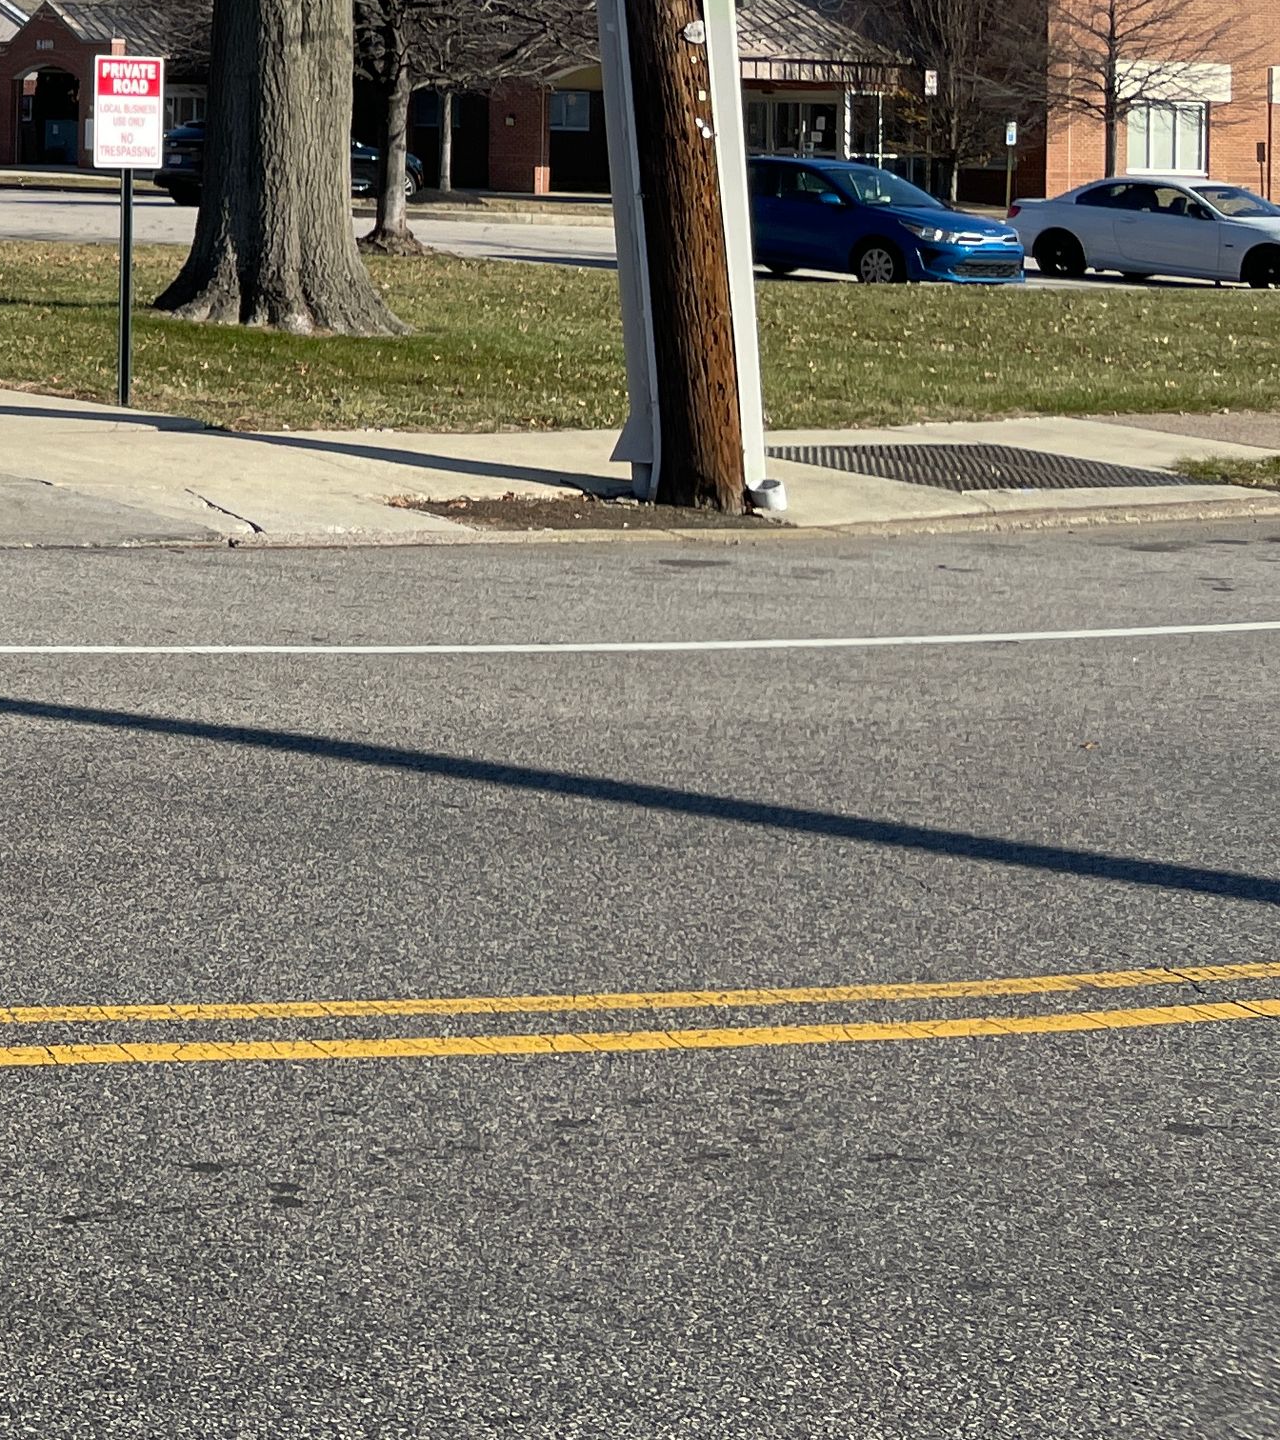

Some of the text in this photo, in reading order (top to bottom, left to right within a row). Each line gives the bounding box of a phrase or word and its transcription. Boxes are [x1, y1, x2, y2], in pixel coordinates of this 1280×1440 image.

[102, 62, 156, 79] PRIVATE
[113, 79, 149, 95] ROAD
[100, 103, 157, 114] LOCAL BUSINESS
[113, 117, 145, 127] USE ONLY
[121, 133, 134, 144] NO
[100, 145, 156, 158] TRESPASSING
